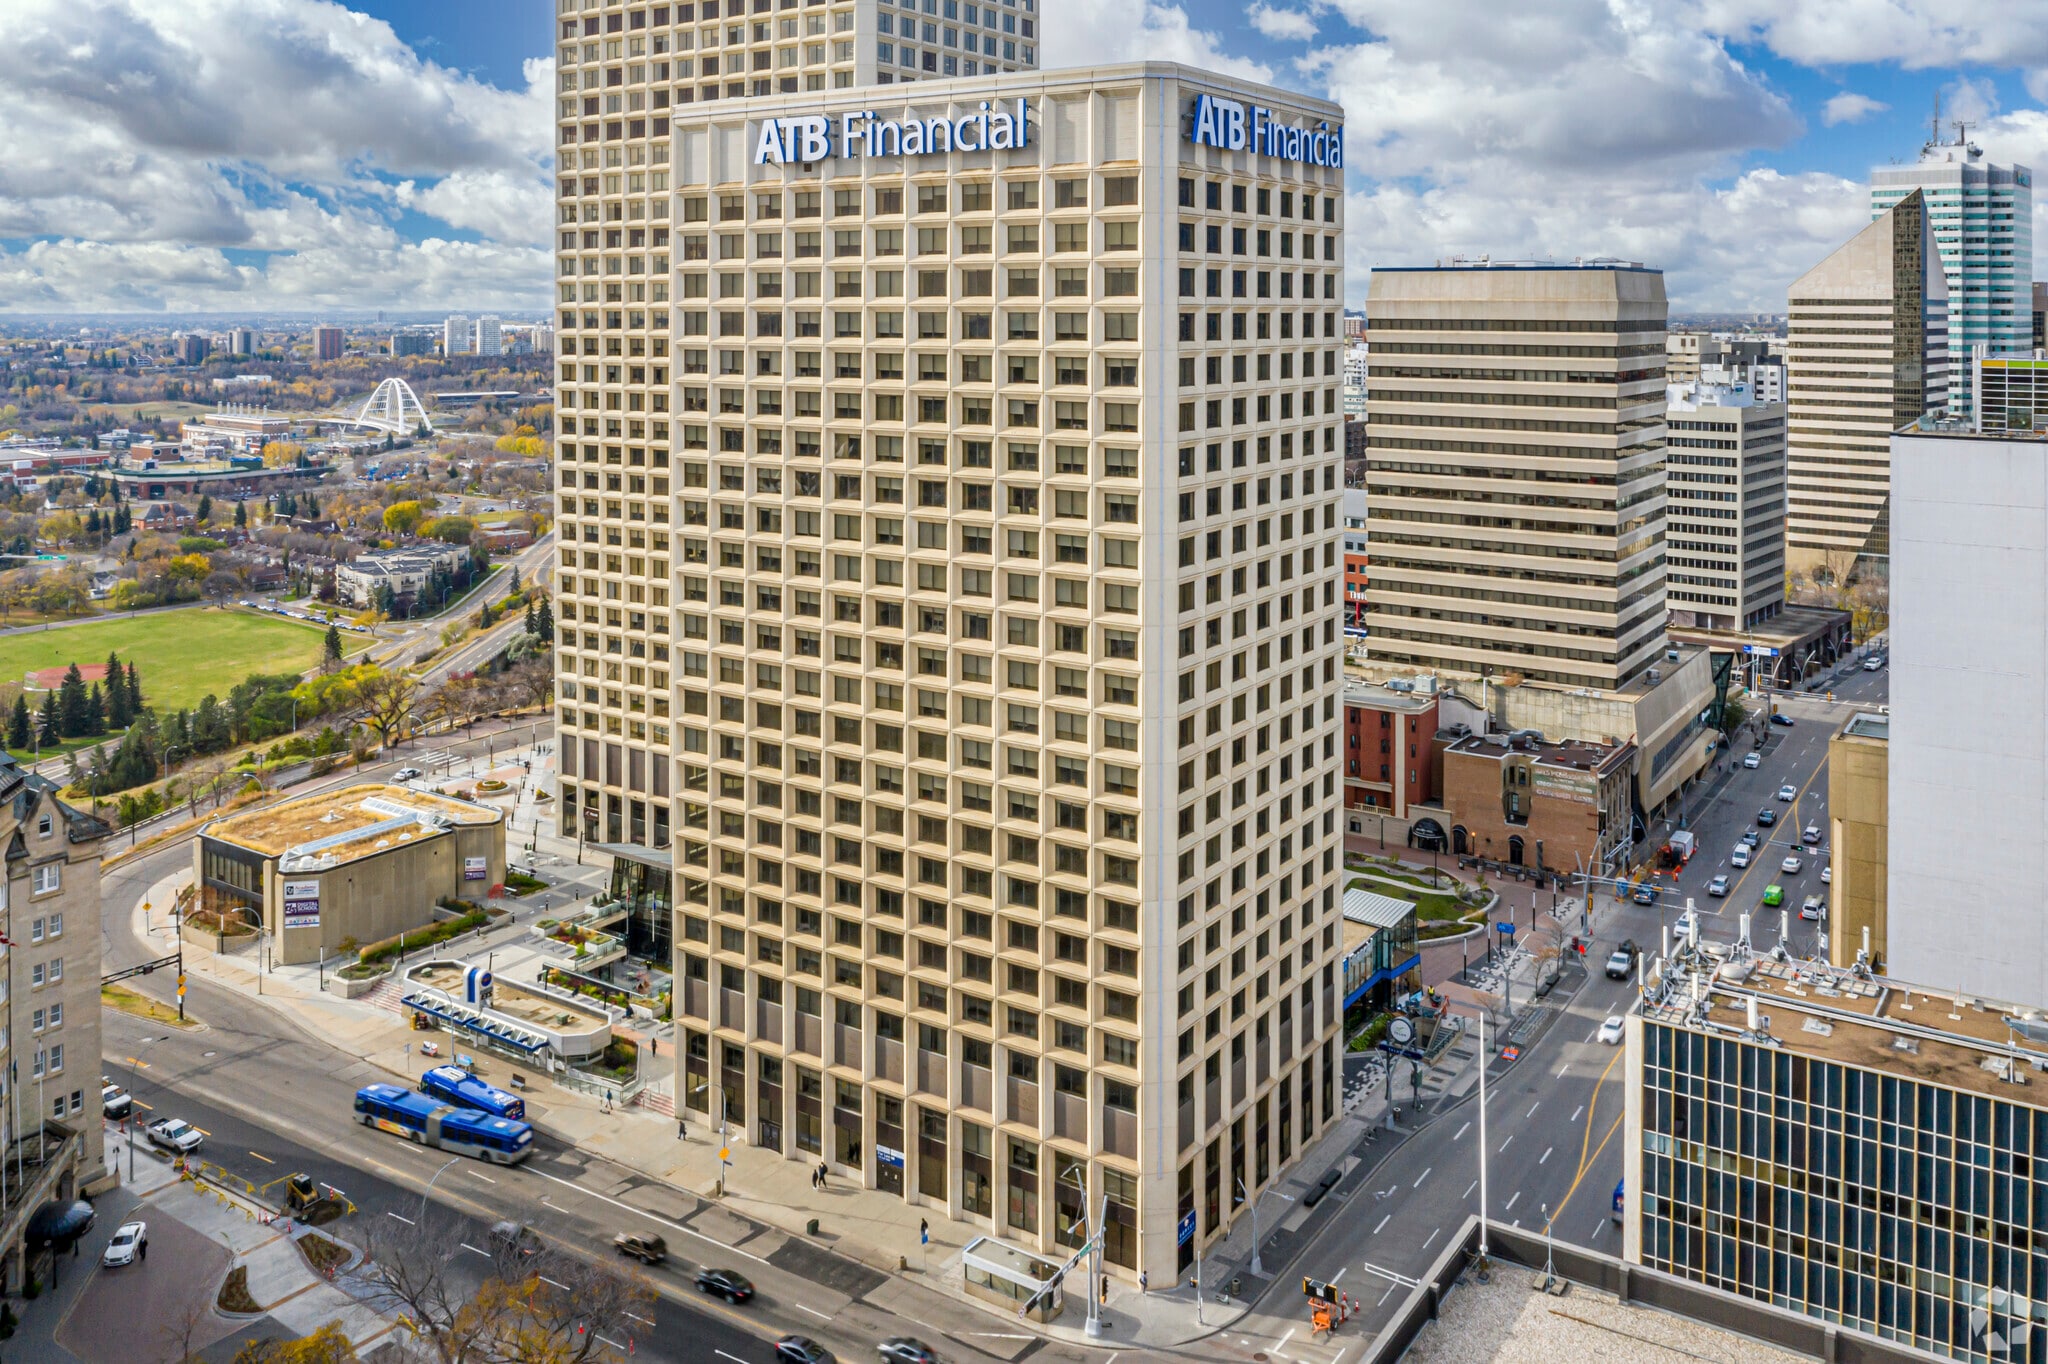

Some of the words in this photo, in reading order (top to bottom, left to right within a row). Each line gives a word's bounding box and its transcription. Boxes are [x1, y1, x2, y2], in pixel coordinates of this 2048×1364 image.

[754, 116, 831, 164] ATB
[843, 98, 1027, 158] Financial
[1191, 94, 1246, 150] ATB
[1250, 105, 1344, 169] Financial
